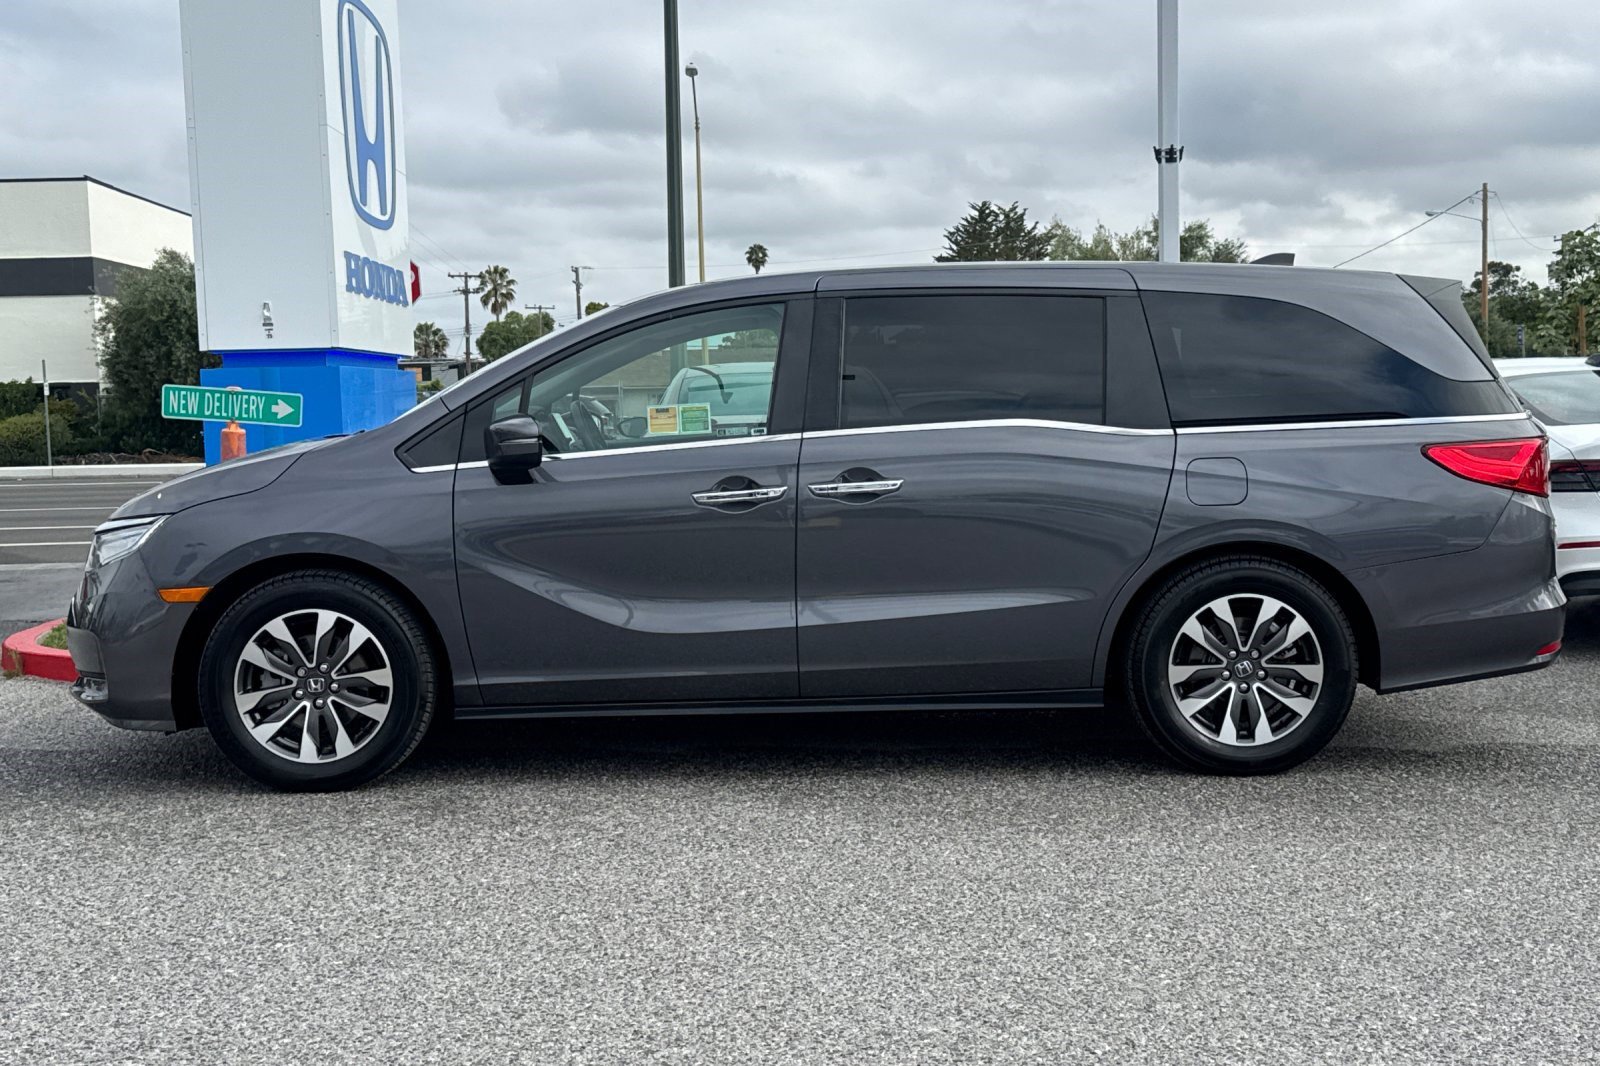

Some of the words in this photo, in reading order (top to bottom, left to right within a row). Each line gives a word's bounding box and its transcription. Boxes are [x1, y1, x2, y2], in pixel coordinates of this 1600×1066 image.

[343, 250, 409, 307] HONDA
[169, 390, 199, 415] NEW
[204, 392, 266, 419] DELIVERY
